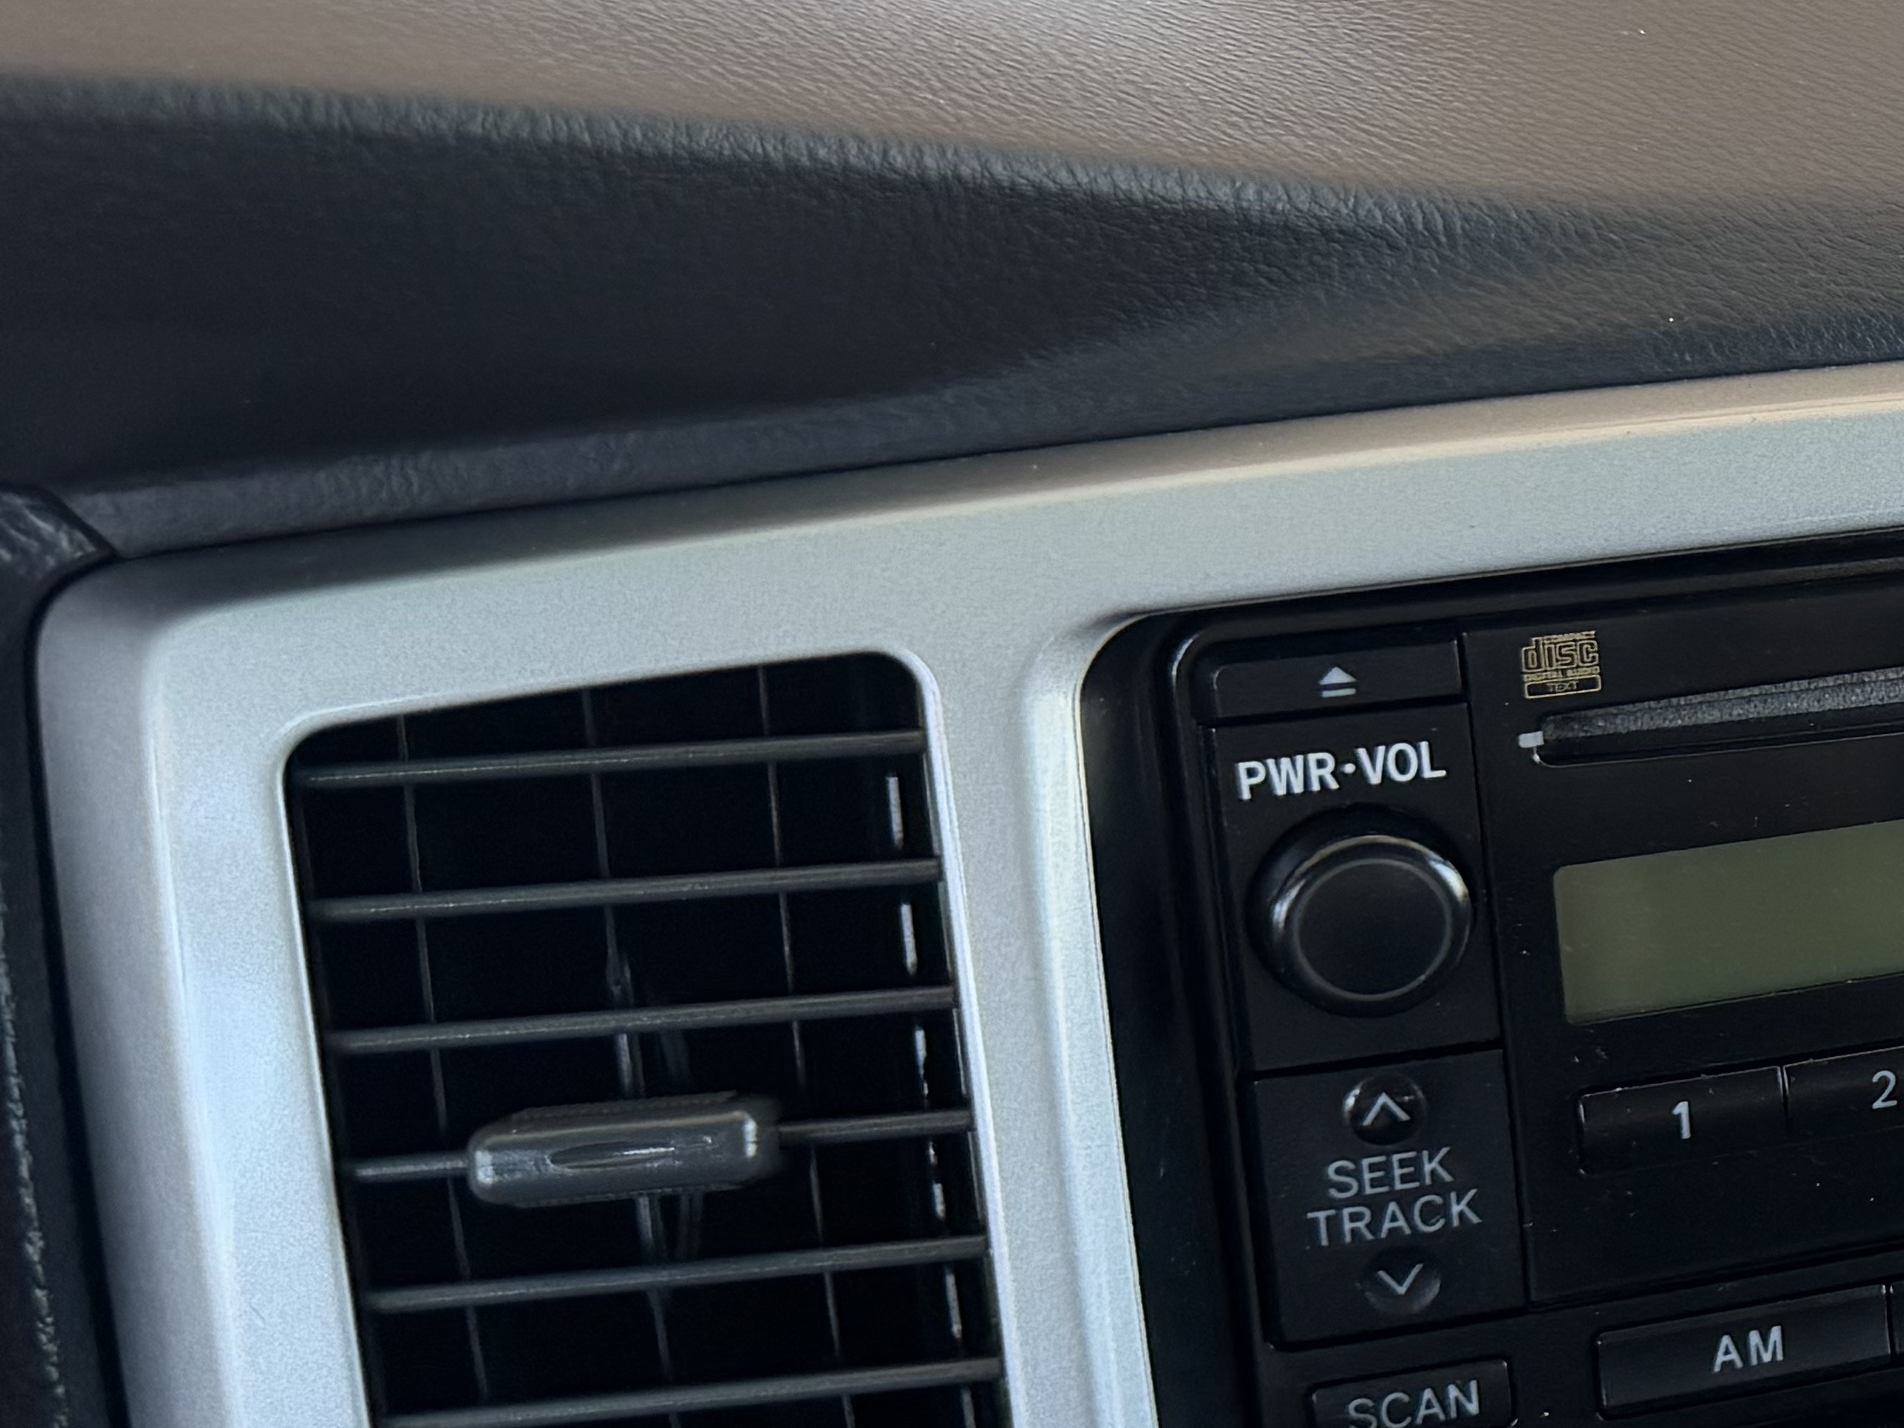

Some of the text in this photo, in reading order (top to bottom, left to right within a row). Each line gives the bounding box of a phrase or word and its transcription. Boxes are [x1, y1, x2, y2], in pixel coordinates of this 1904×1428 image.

[1521, 637, 1600, 673] disc
[1870, 1070, 1899, 1110] 2
[1672, 1102, 1692, 1139] 1
[1326, 1147, 1452, 1199] SEEK
[1307, 1186, 1482, 1246] TRACK
[1713, 1327, 1784, 1371] AM
